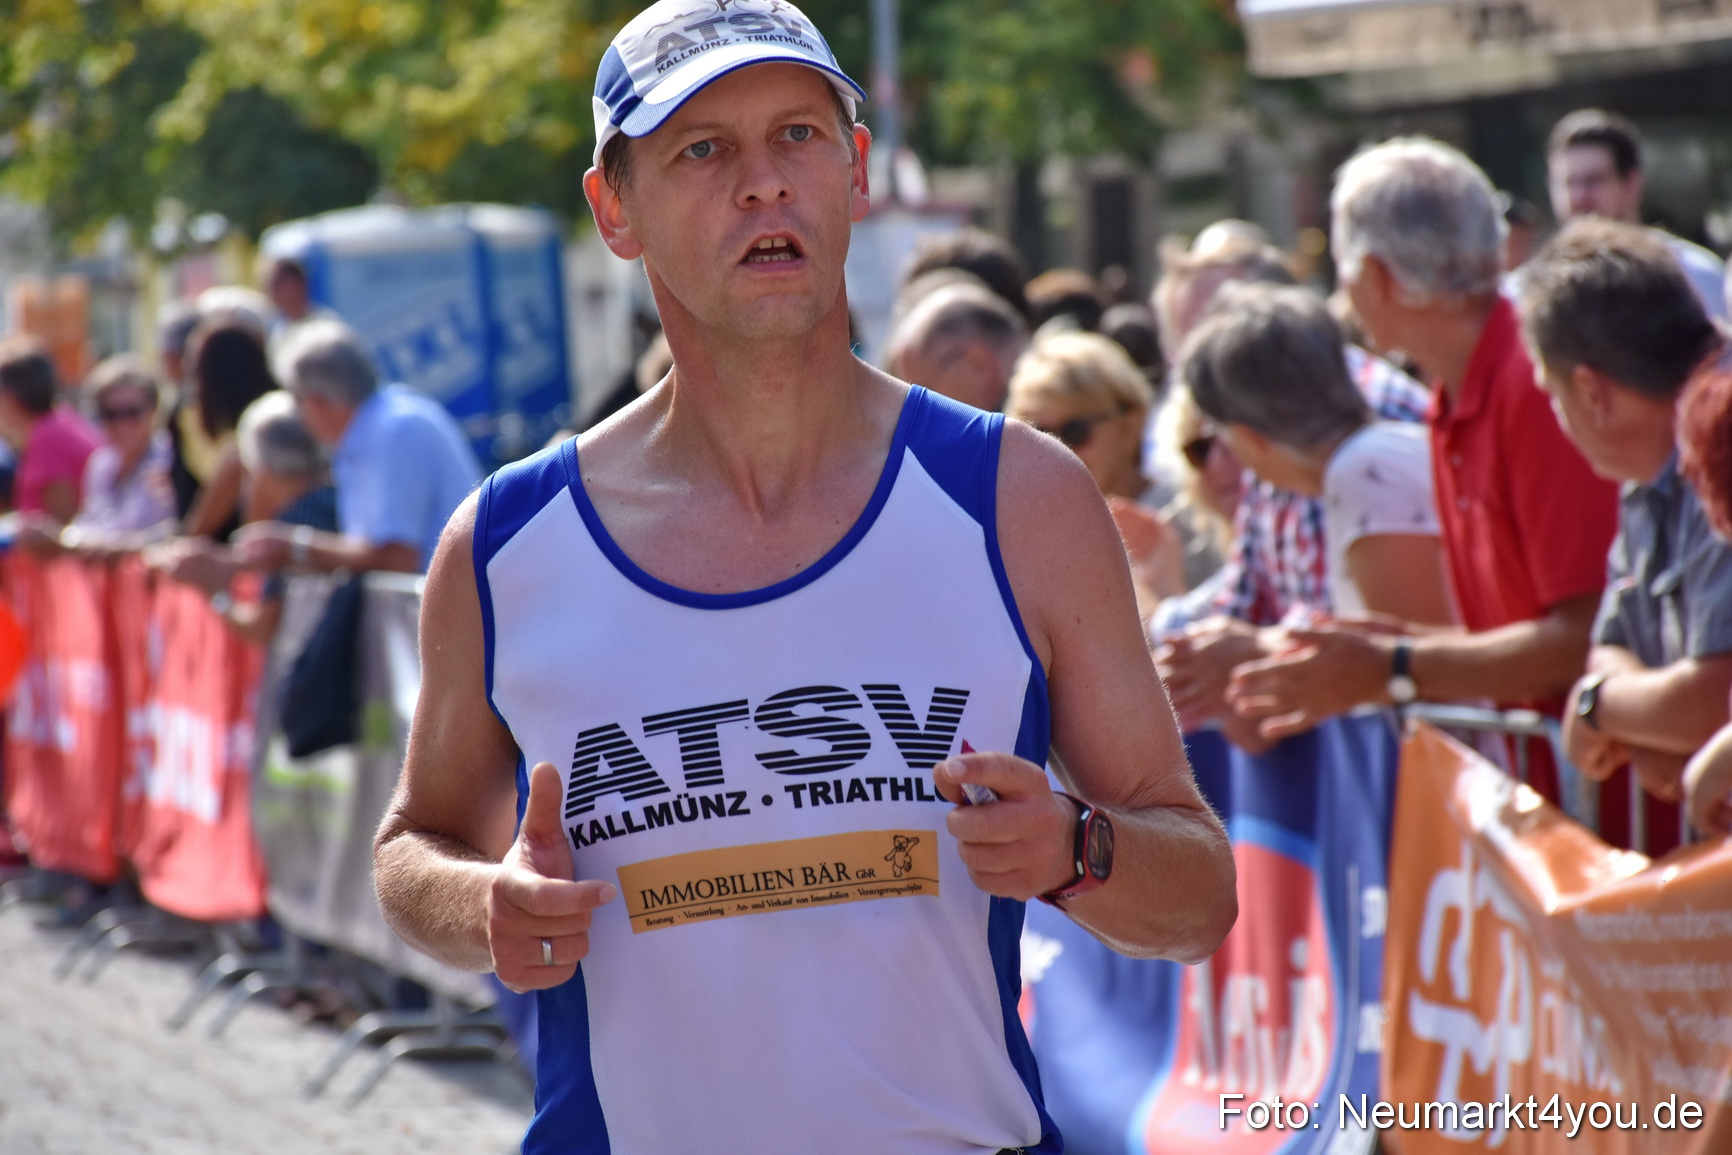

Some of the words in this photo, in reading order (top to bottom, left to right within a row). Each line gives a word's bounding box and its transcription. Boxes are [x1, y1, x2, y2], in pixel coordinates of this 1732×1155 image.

[655, 12, 805, 66] ATSV
[656, 37, 731, 74] KALLMÜNZ
[744, 33, 814, 52] TRIATHLON
[564, 684, 970, 819] ATSV
[568, 790, 750, 850] KALLMÜNZ
[785, 776, 951, 808] TRIATHL
[640, 867, 794, 910] IMMOBILIEN
[801, 861, 852, 887] BÄR
[855, 868, 876, 879] GbR
[645, 914, 675, 928] Beratung
[683, 906, 725, 920] Vermittlung
[751, 901, 765, 910] und
[766, 897, 794, 908] Verkauf
[795, 896, 809, 904] von
[811, 890, 850, 903] Immobilien
[857, 882, 923, 898] Versteigerungsobjekte
